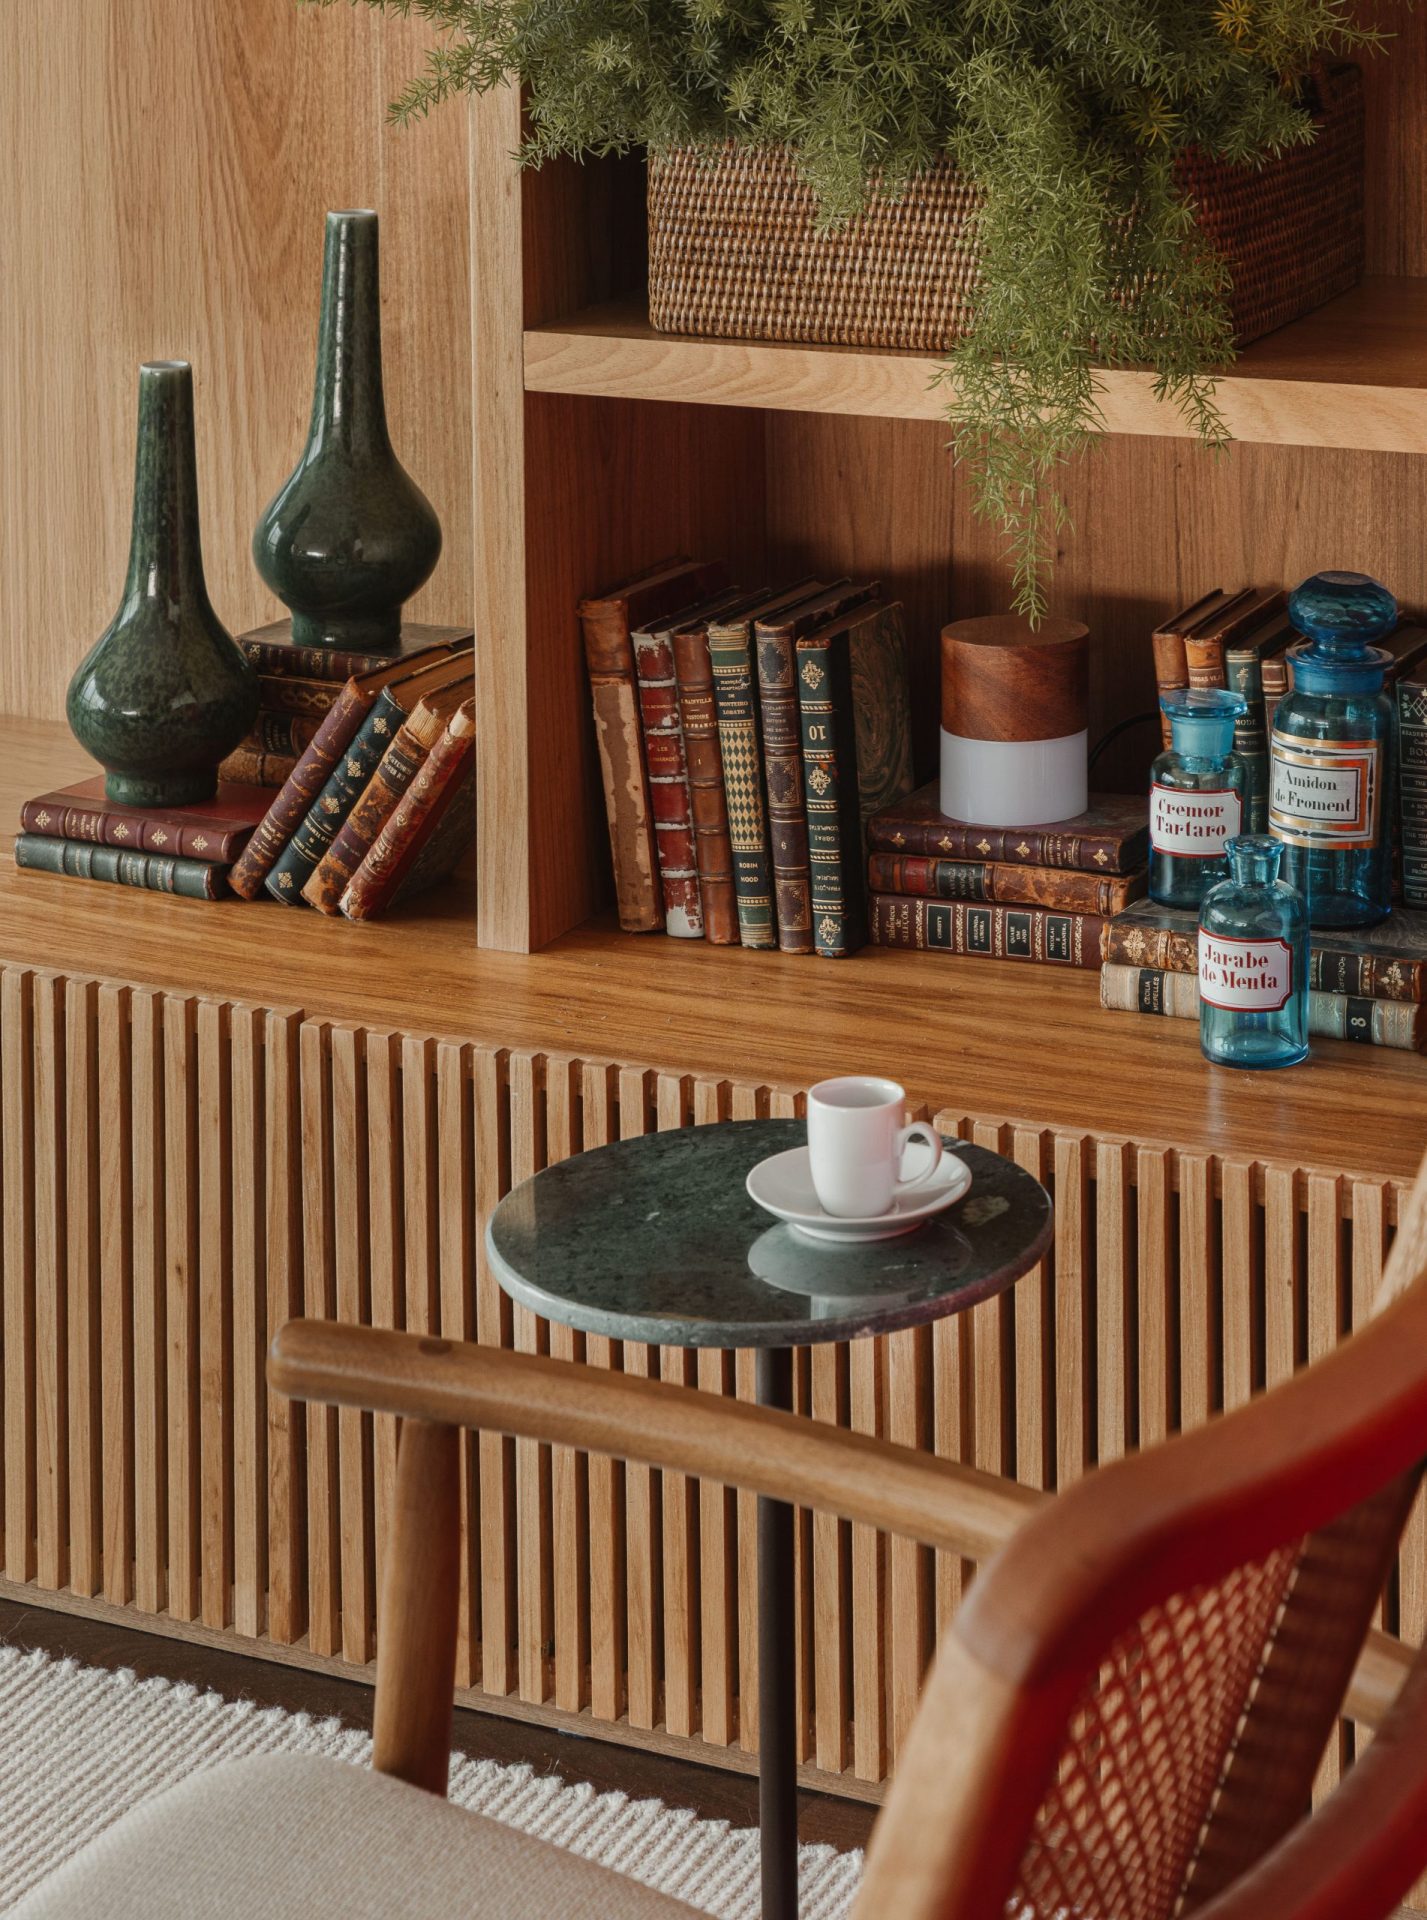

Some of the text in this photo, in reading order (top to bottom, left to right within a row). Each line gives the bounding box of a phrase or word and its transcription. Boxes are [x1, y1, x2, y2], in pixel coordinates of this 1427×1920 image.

[809, 725, 826, 740] 10
[1284, 769, 1337, 791] Amidon
[1158, 798, 1224, 817] Cremor
[1275, 788, 1351, 812] de Froment
[1156, 815, 1226, 837] Tartaro
[1205, 944, 1268, 969] Jarabe
[1202, 964, 1278, 990] de Menta
[1351, 1017, 1367, 1027] 8
